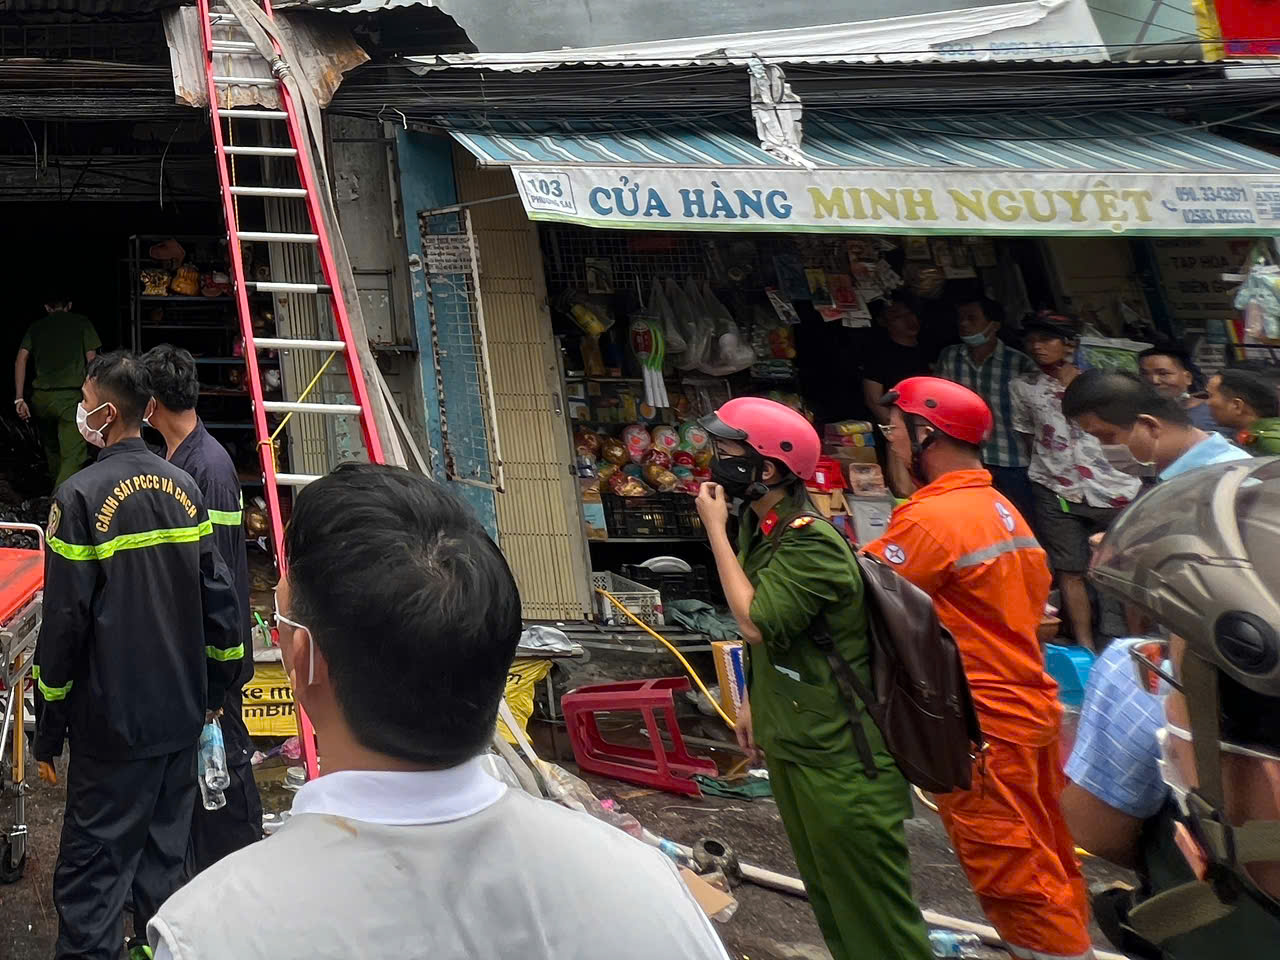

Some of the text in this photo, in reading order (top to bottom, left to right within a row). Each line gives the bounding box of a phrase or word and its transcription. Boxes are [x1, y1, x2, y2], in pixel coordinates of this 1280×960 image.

[528, 178, 563, 198] 103
[589, 176, 1153, 233] CỬA HÀNG MINH NGUYỆT
[94, 474, 198, 533] CẢNH SÁT PCCC VÀ CNCH
